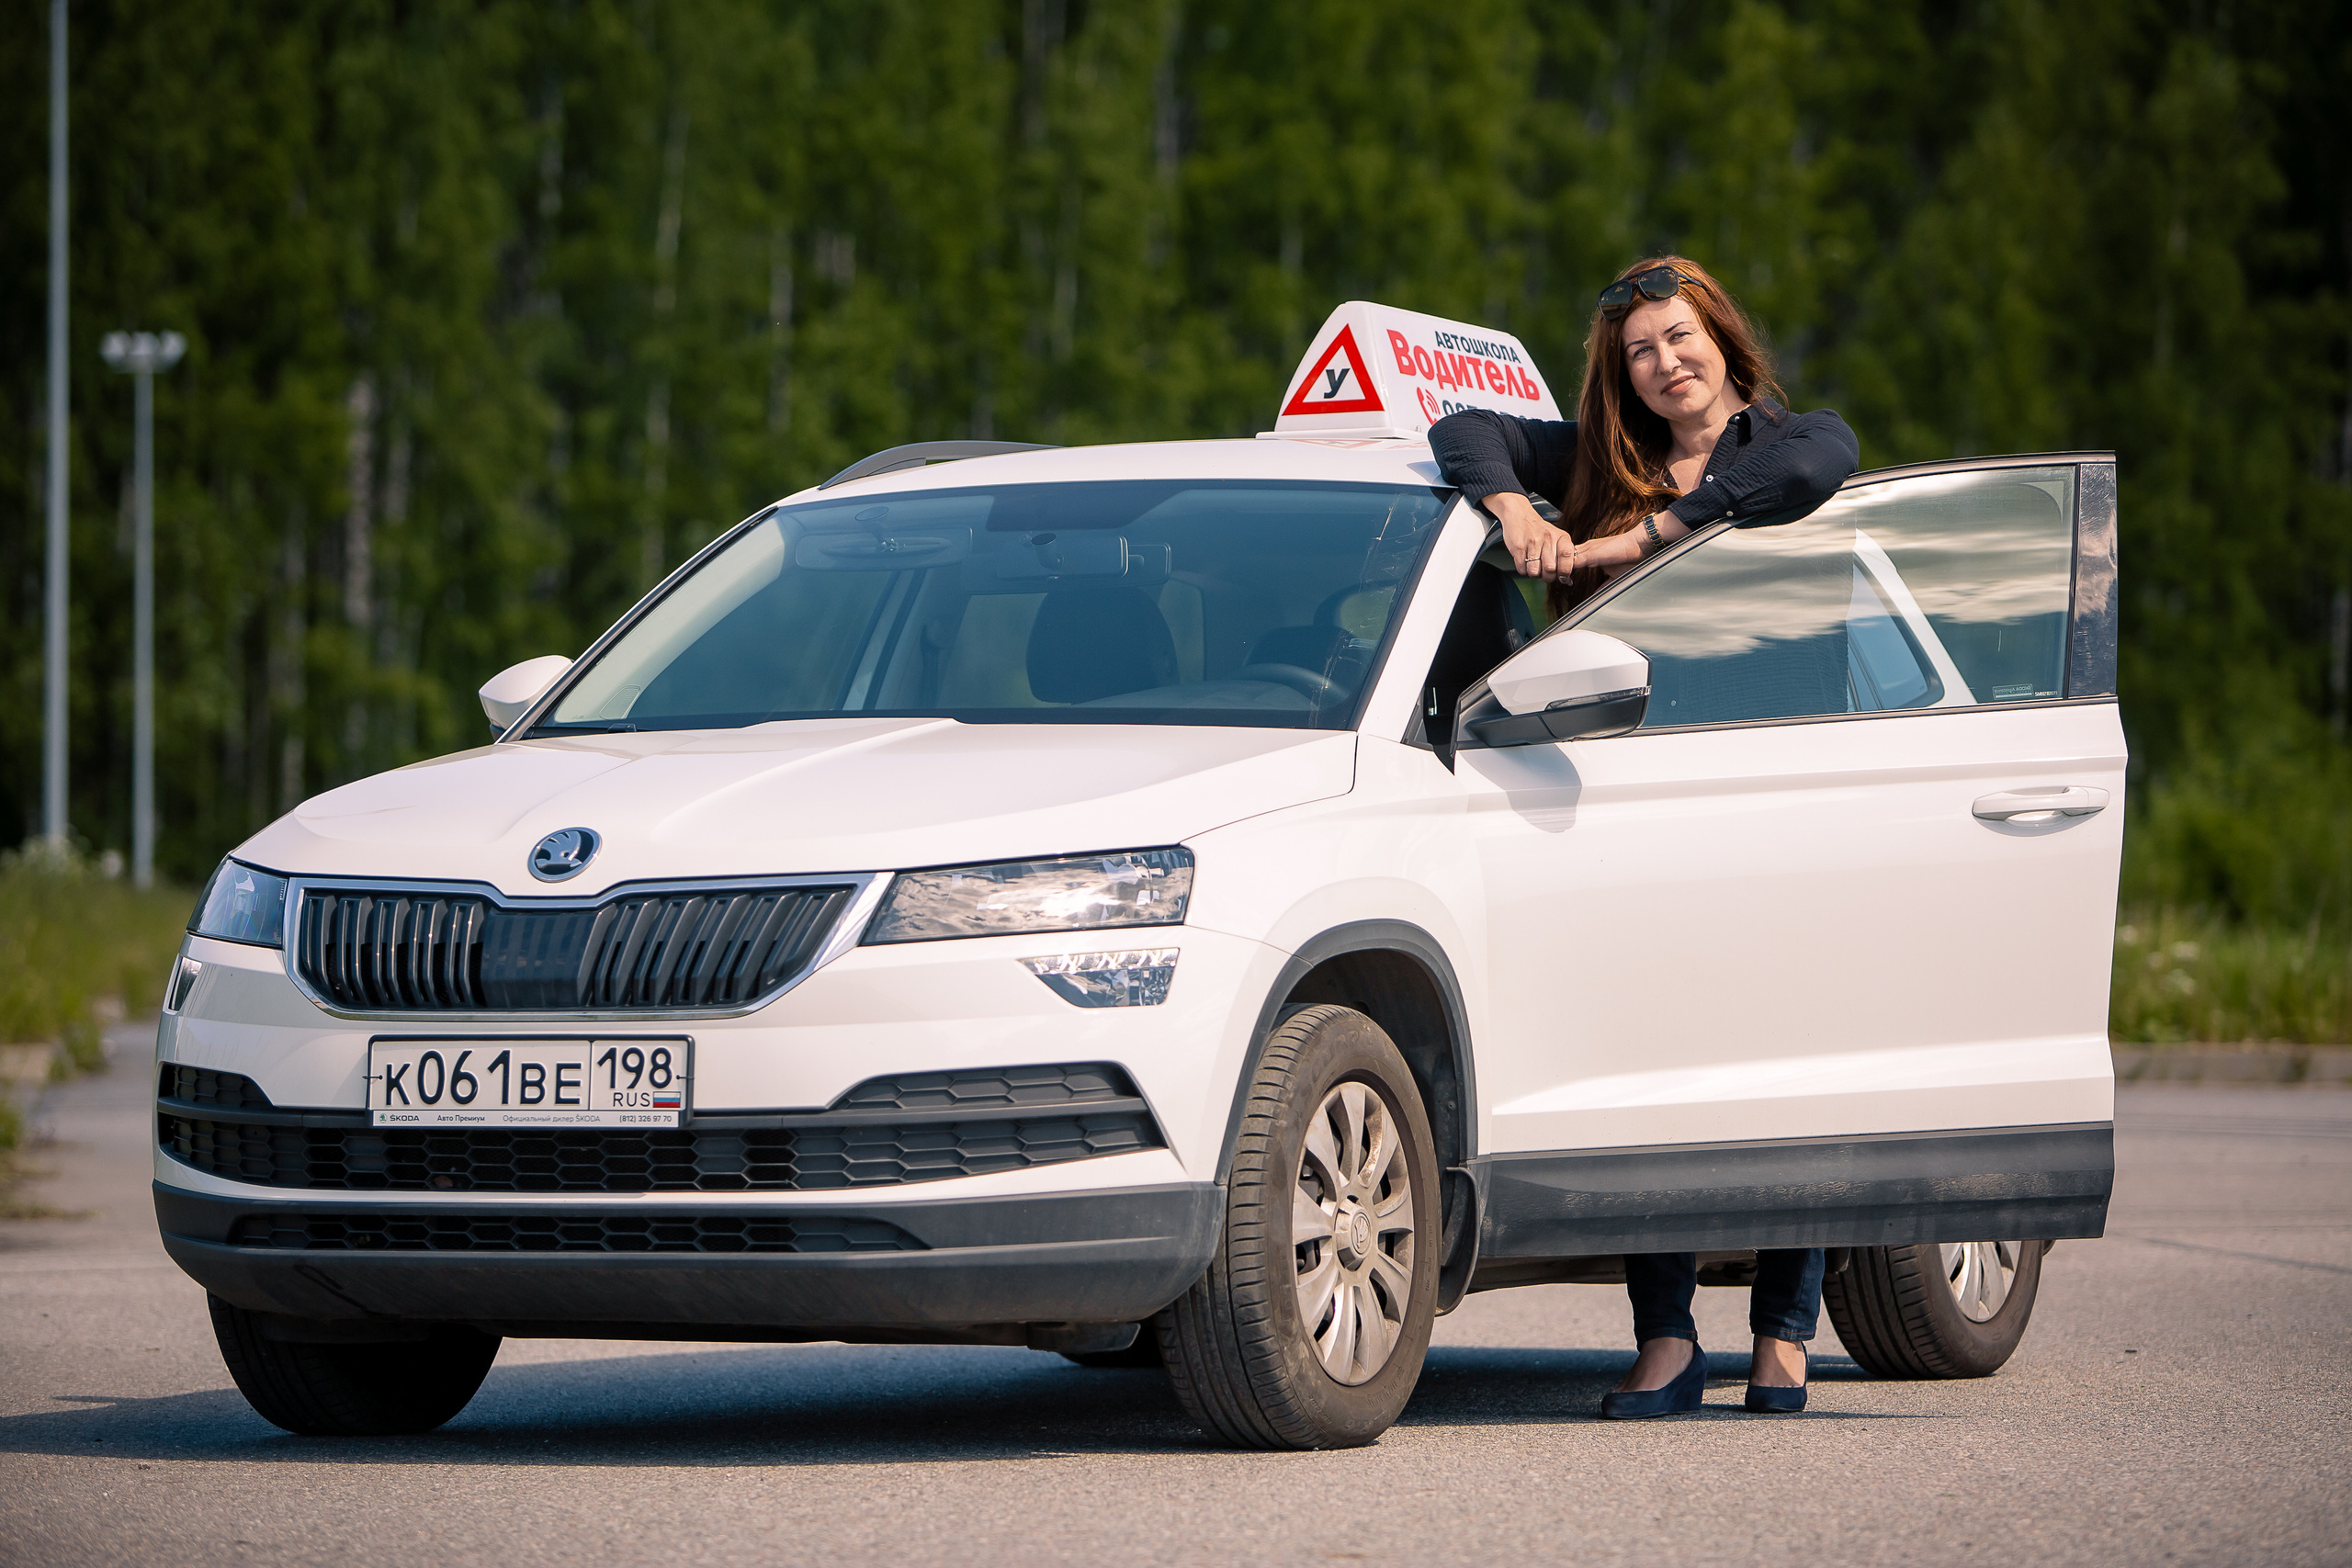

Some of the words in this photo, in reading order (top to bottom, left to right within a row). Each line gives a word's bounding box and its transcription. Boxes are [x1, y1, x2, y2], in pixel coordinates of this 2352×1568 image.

[1434, 331, 1521, 364] АВТОШКОЛА
[1323, 367, 1351, 399] У
[596, 1046, 673, 1089] 198
[612, 1091, 650, 1108] RUS
[455, 1114, 485, 1123] Премиум
[503, 1113, 551, 1123] Официальный
[552, 1115, 574, 1123] дилер
[575, 1113, 601, 1122] ŠKODA
[619, 1114, 637, 1122] (812)
[638, 1114, 651, 1122] 326
[653, 1114, 662, 1122] 97
[663, 1114, 673, 1122] 70
